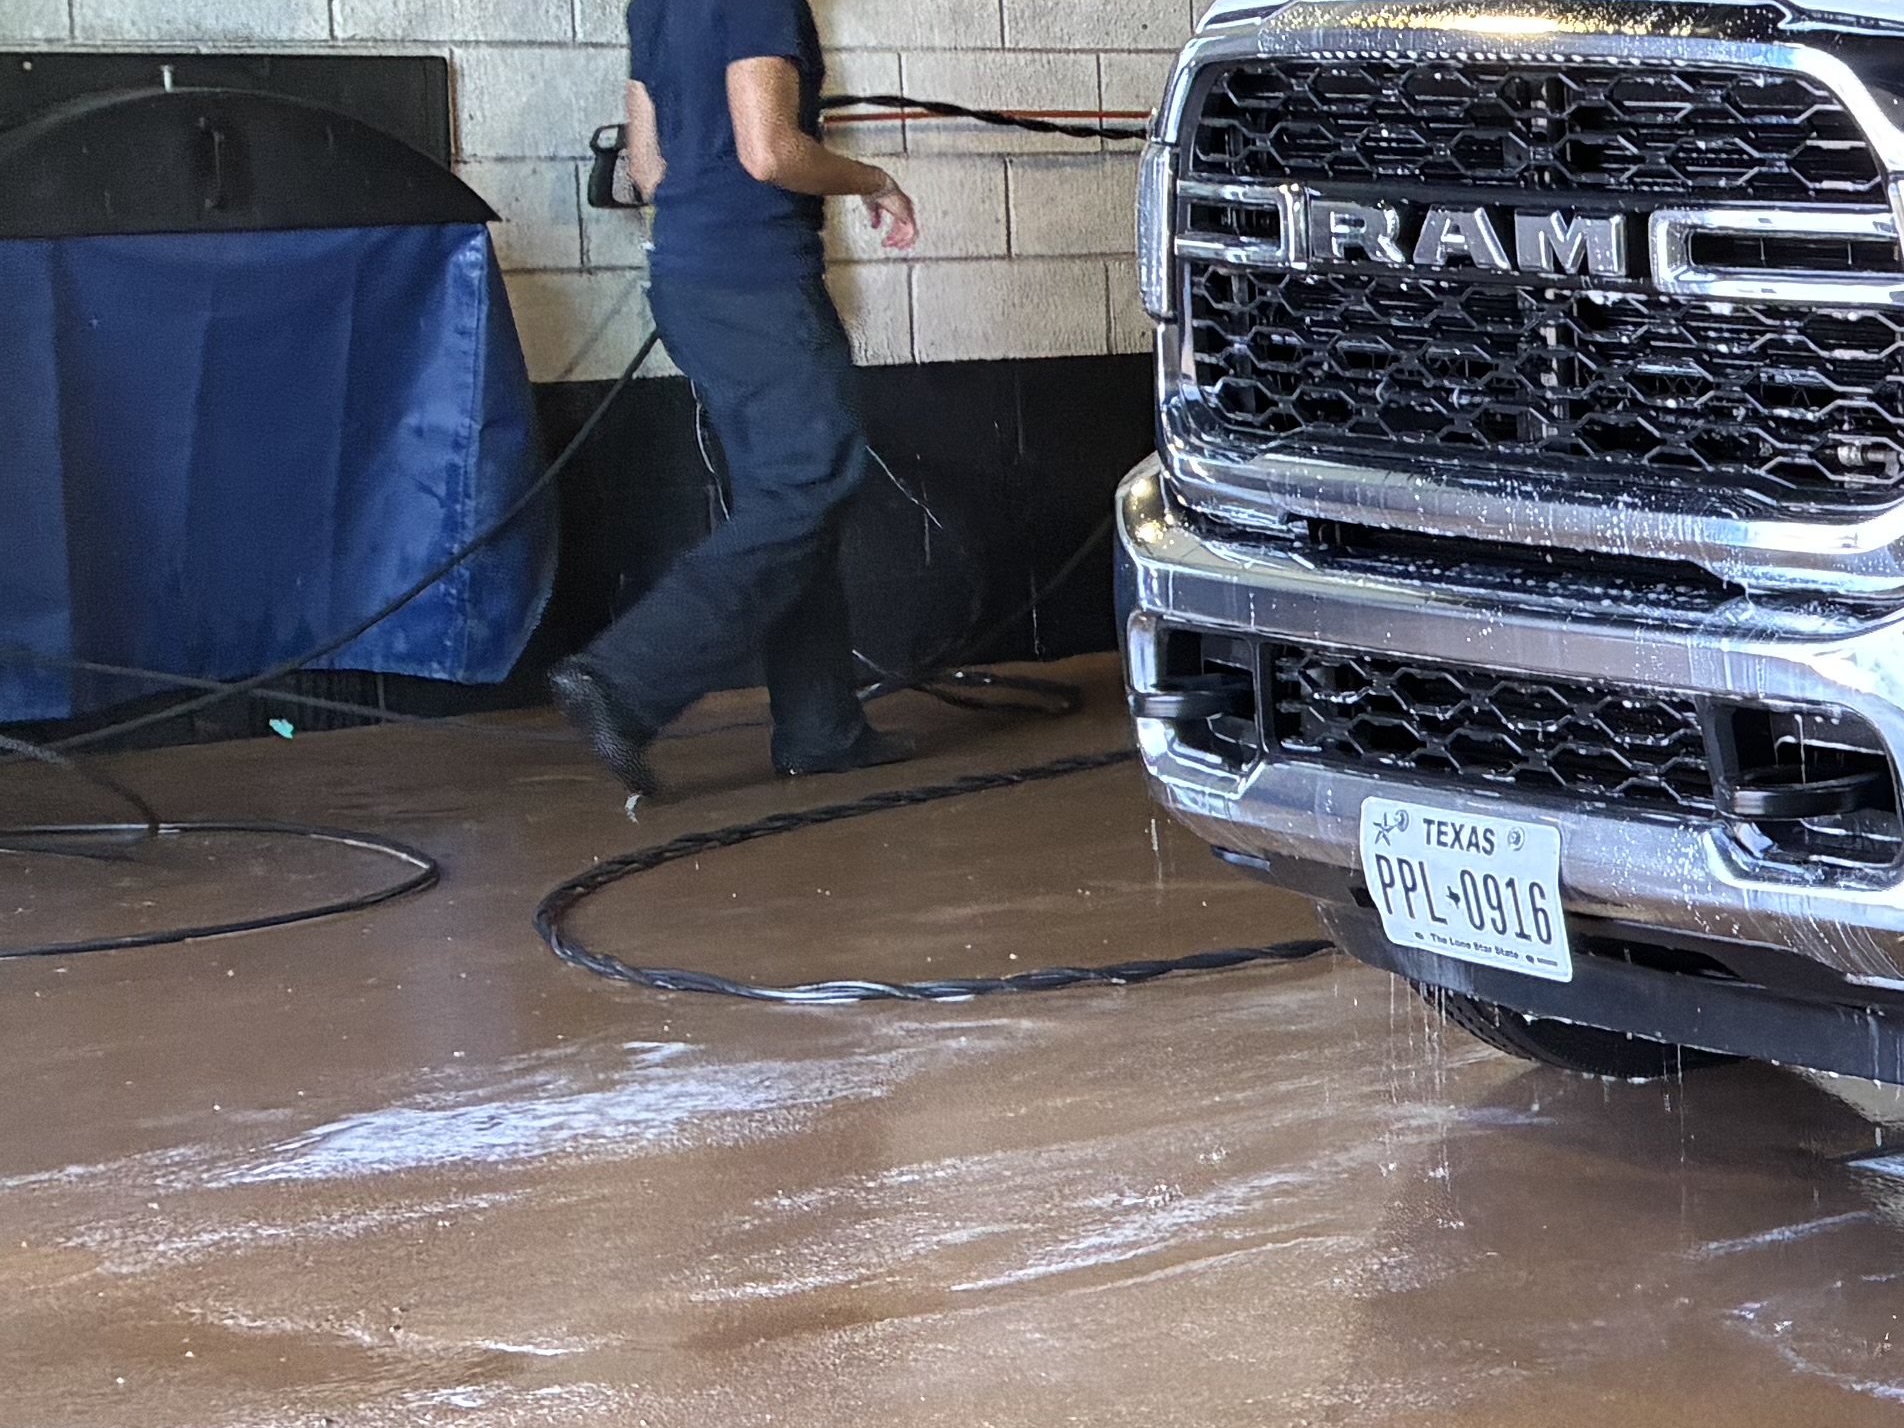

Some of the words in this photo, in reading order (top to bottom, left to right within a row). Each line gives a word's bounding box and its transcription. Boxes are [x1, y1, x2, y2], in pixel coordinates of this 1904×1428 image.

[1309, 198, 1627, 277] RAM
[1422, 817, 1496, 856] TEXAS
[1430, 932, 1448, 945] The
[1449, 936, 1472, 950] Lone
[1473, 941, 1492, 954] Star
[1494, 945, 1519, 960] State
